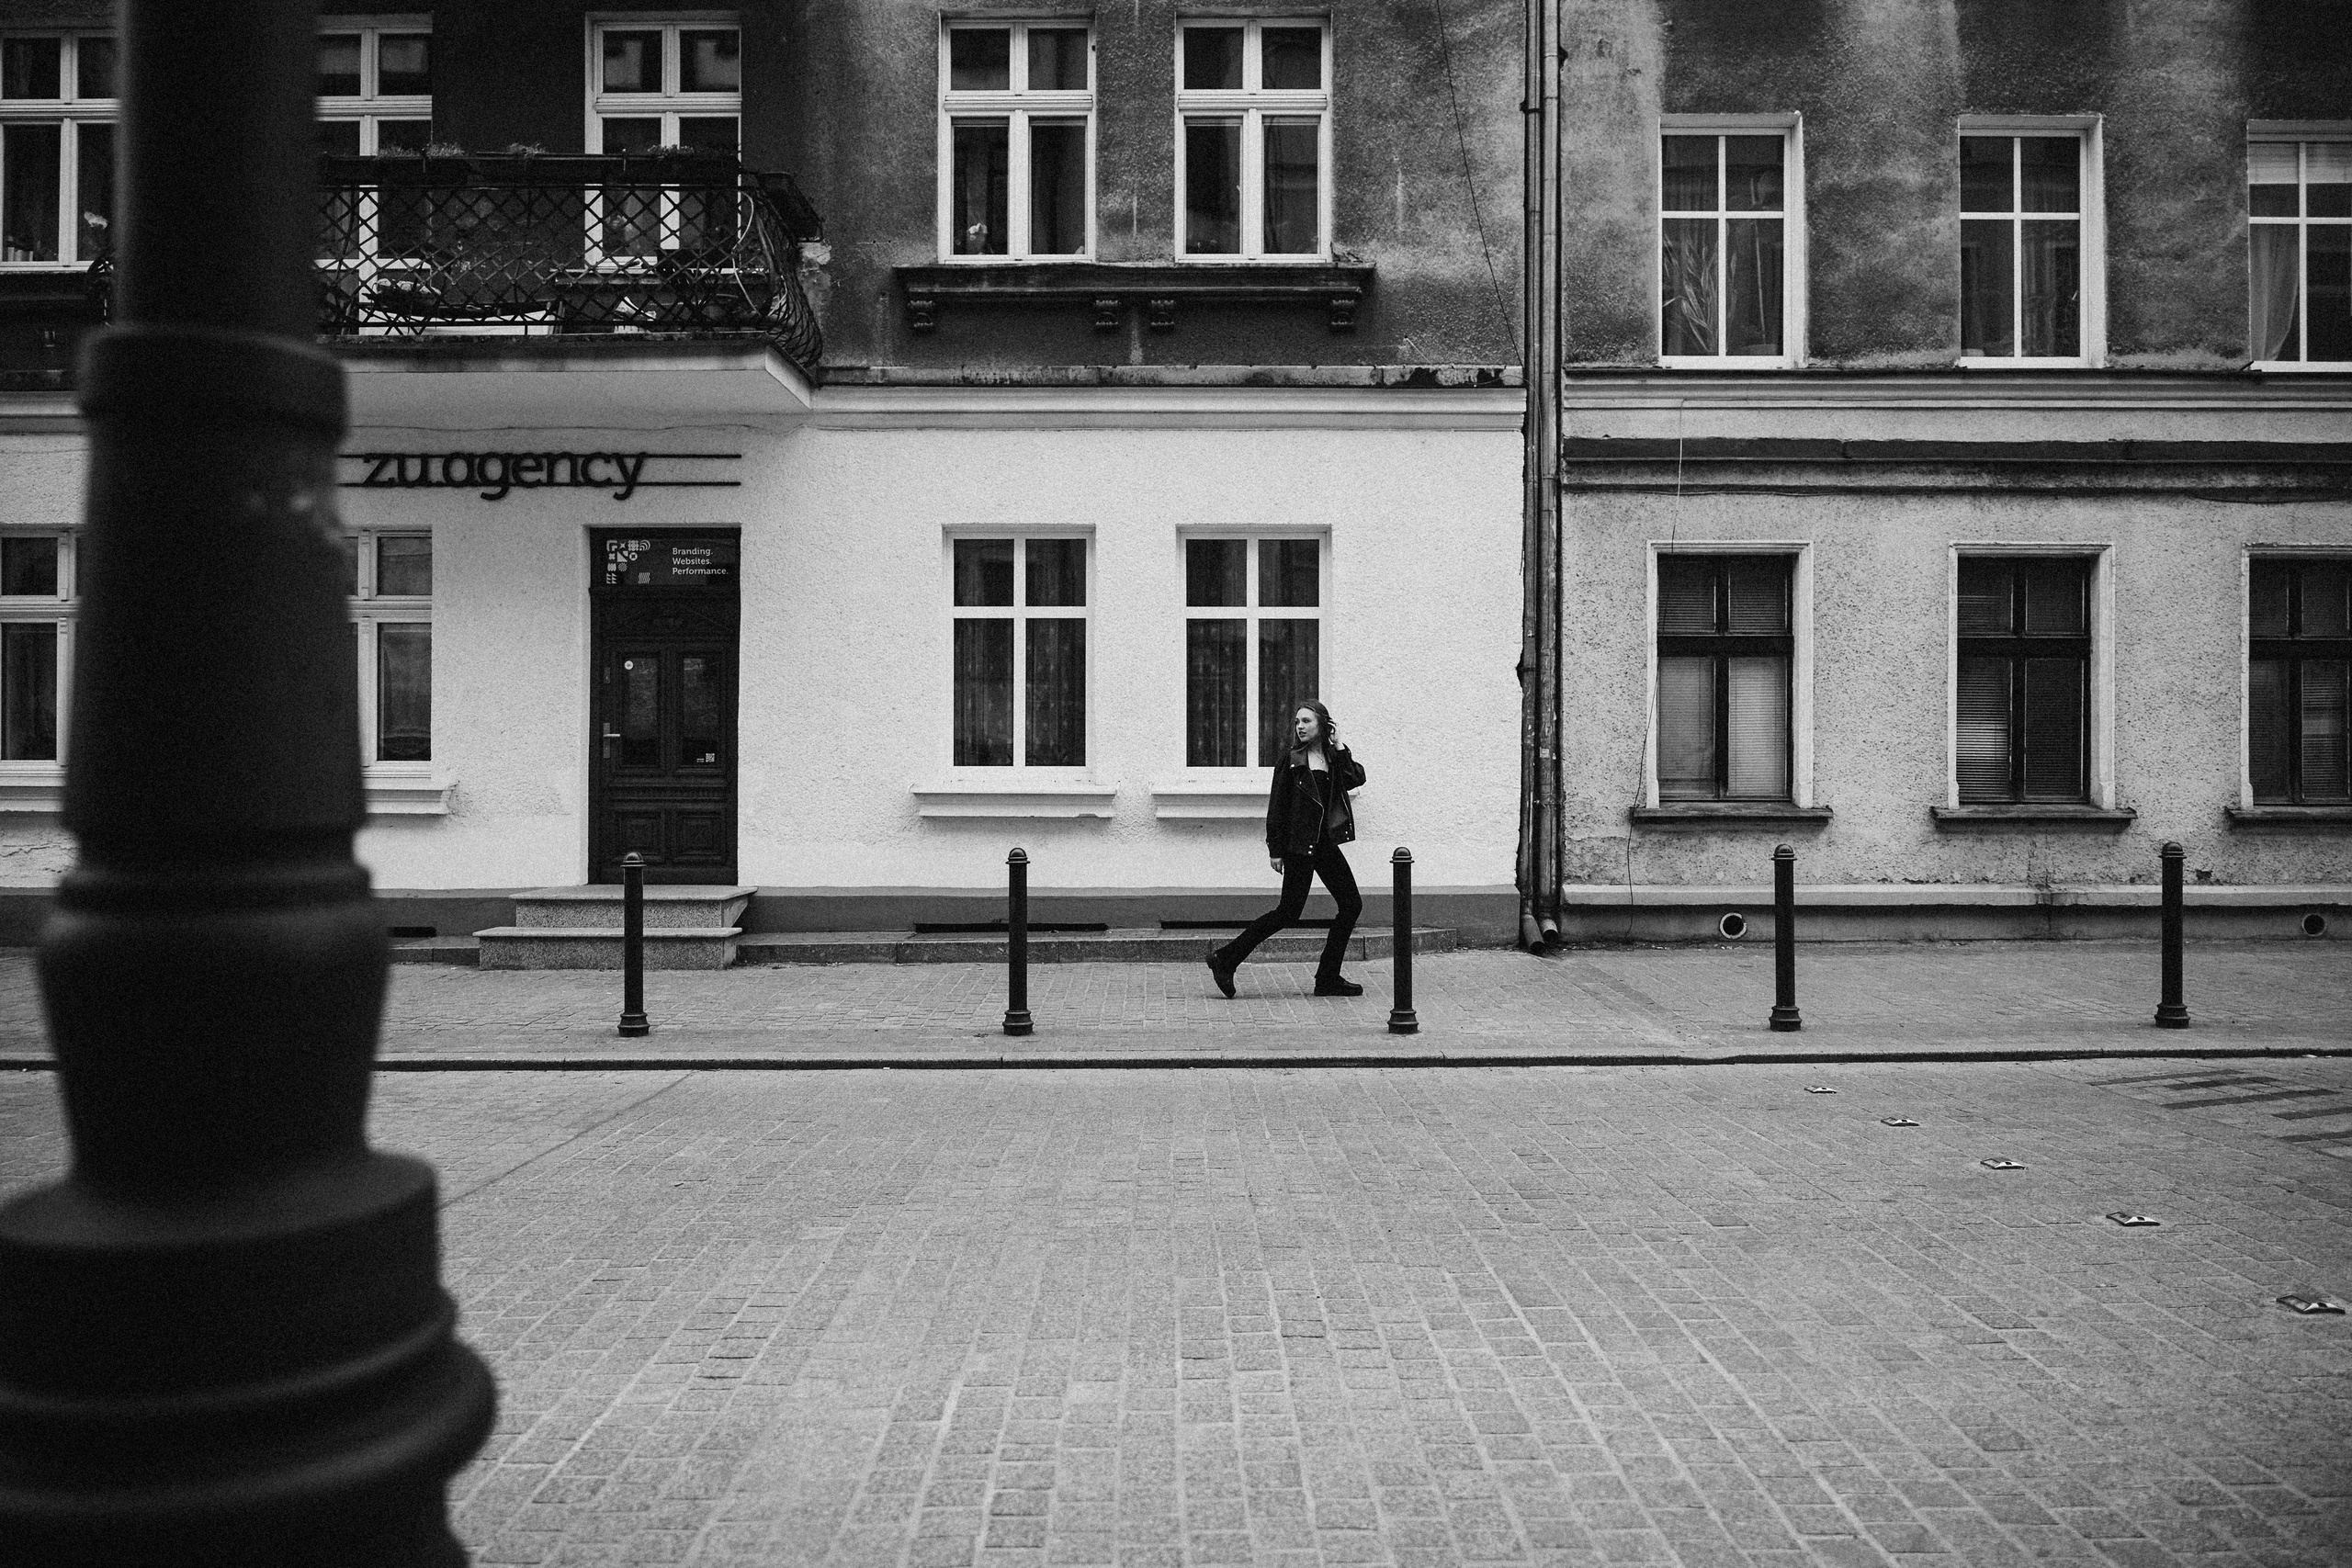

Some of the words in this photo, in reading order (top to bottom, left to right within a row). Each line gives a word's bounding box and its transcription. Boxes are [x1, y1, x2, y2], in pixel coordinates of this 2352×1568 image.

[672, 547, 714, 557] Branding.
[672, 557, 712, 565] Websites.
[672, 567, 729, 575] Performance.
